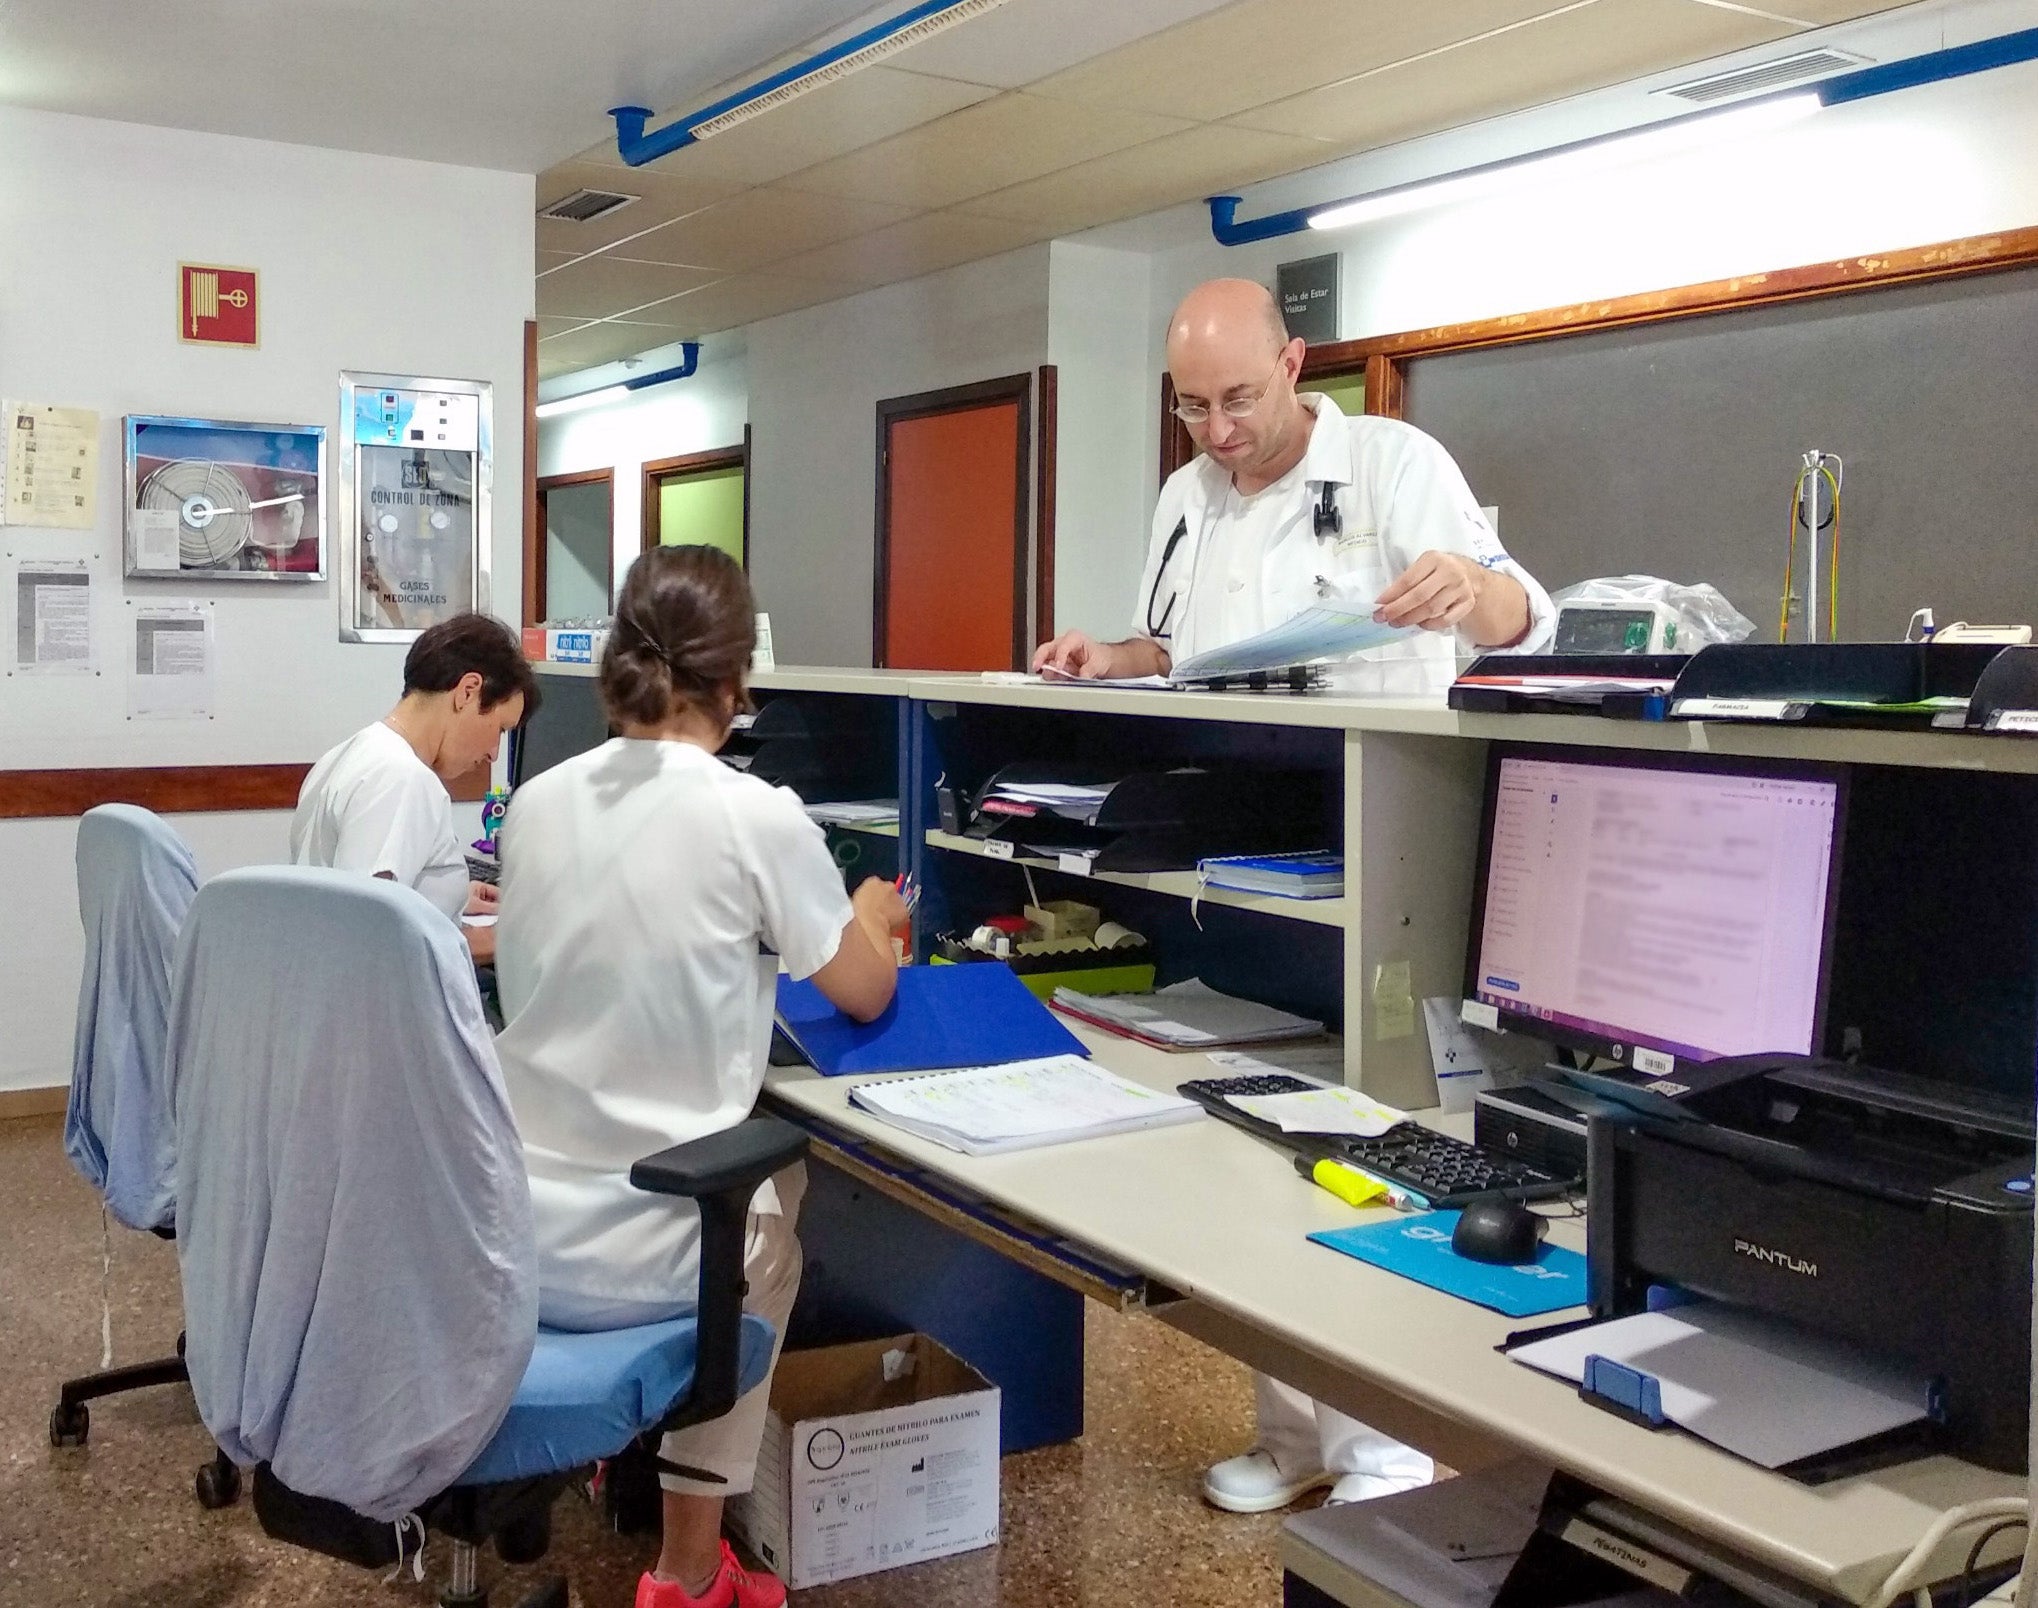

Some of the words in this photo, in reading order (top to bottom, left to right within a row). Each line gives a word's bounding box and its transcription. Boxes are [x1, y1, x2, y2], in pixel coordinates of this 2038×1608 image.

[1285, 293, 1298, 303] Sala
[1300, 291, 1309, 301] de
[1310, 288, 1329, 299] Estar
[1285, 304, 1307, 314] Visitas
[371, 490, 414, 505] CONTROL
[419, 492, 430, 506] DE
[435, 492, 460, 507] ZONA
[400, 581, 430, 592] GASES
[383, 593, 447, 605] MEDICINALES
[1734, 1239, 1818, 1277] PANTUM
[849, 1426, 887, 1441] GUANTES
[930, 1415, 949, 1426] PARA
[950, 1409, 981, 1422] EXAMEN
